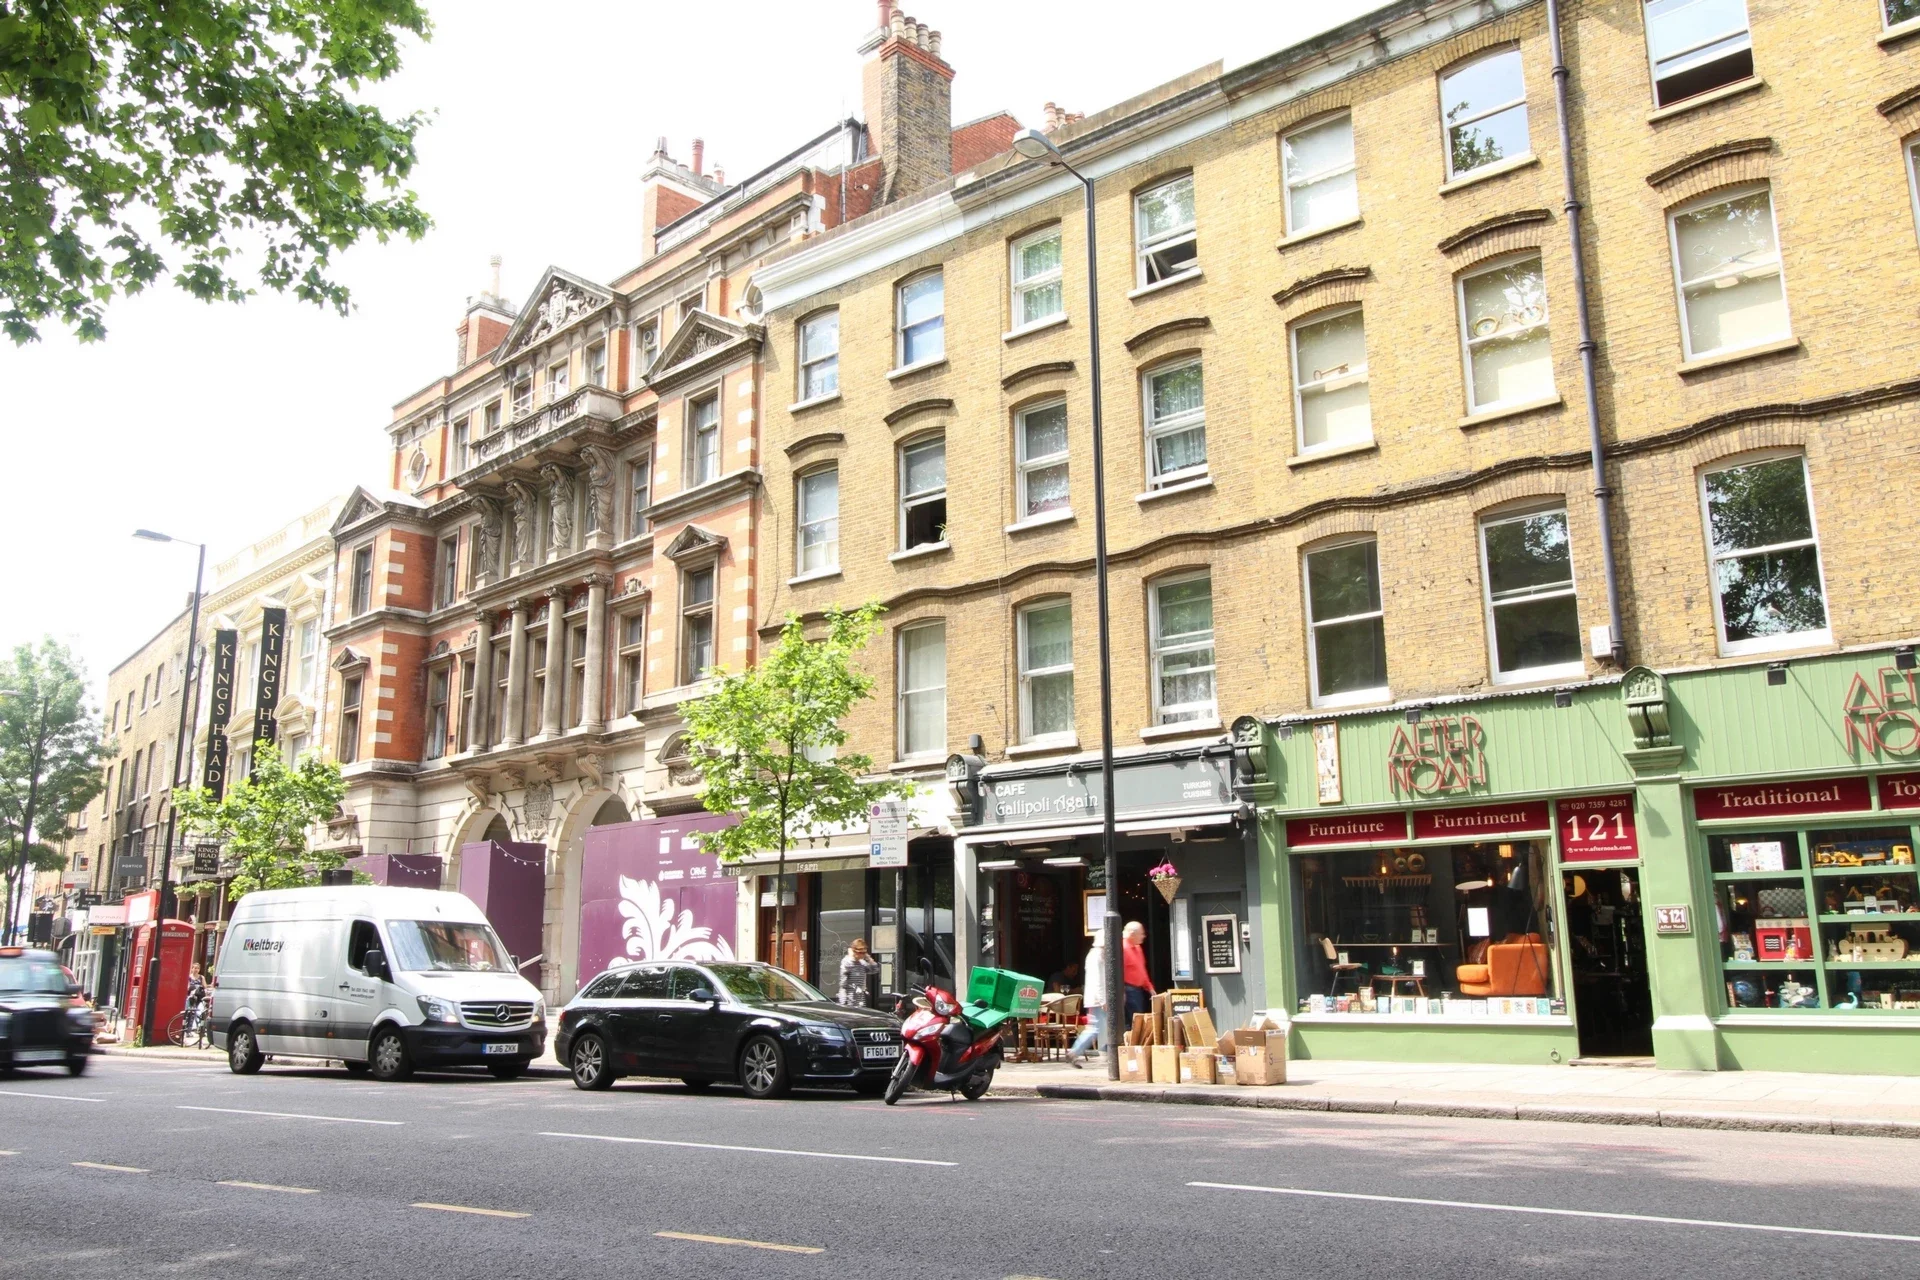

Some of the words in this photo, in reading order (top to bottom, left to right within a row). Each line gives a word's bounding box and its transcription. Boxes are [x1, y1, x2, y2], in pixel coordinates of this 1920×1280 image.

[263, 623, 280, 700] KINGS
[216, 643, 232, 717] KINGS
[1388, 716, 1483, 758] AFTER
[1844, 709, 1920, 756] NO
[208, 723, 226, 783] HEAD
[1388, 751, 1486, 795] NOAH
[995, 783, 1025, 797] CAFE
[1182, 780, 1212, 790] TURKISH
[1182, 789, 1212, 799] CUISINE
[1718, 785, 1841, 808] Traditional
[996, 796, 1051, 818] Gallipoli
[1053, 792, 1099, 813] Again
[1571, 802, 1585, 810] 020
[1609, 799, 1627, 807] 4281
[1433, 810, 1528, 829] Furniment
[1566, 812, 1628, 842] 121
[1308, 820, 1385, 837] Furniture
[198, 846, 219, 854] KING'S
[873, 844, 880, 855] P
[1573, 845, 1632, 853] www.afternoah.com
[728, 867, 741, 876] 119
[1669, 909, 1685, 923] 121
[249, 939, 285, 953] keltbray
[866, 1047, 884, 1057] FT60
